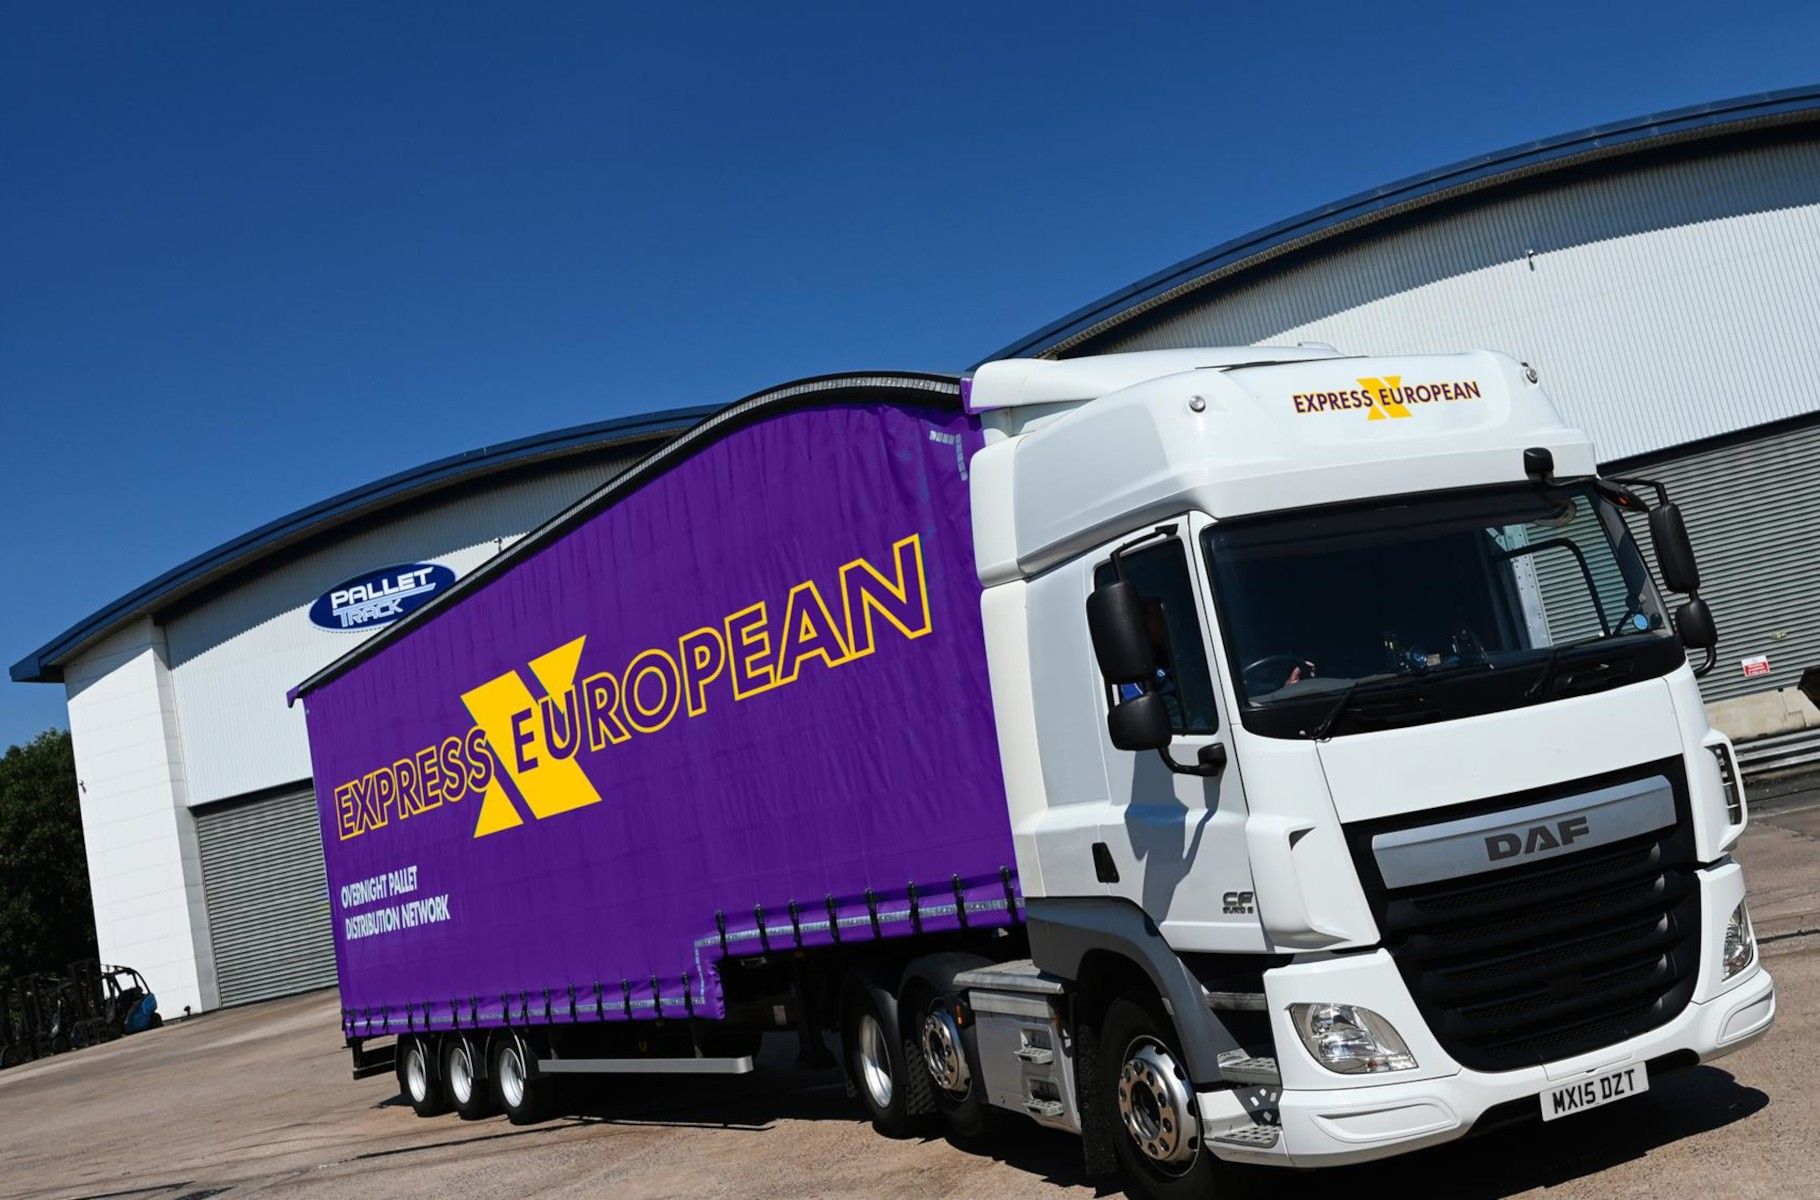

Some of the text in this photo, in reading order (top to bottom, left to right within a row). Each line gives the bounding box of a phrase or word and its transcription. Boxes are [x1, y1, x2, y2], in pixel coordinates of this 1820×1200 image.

[1293, 381, 1481, 413] EXPRESS EUROPEAN
[330, 567, 434, 609] PALLET
[332, 599, 403, 628] TRACK
[334, 533, 932, 841] EXPRESS EUROPEAN
[1484, 816, 1590, 861] DAF
[341, 865, 417, 908] OVERNIGHT PALLET
[1222, 891, 1254, 907] CF
[345, 894, 450, 940] DISTRIBUTION NETWORK
[1552, 1069, 1635, 1114] MX15 DZT
